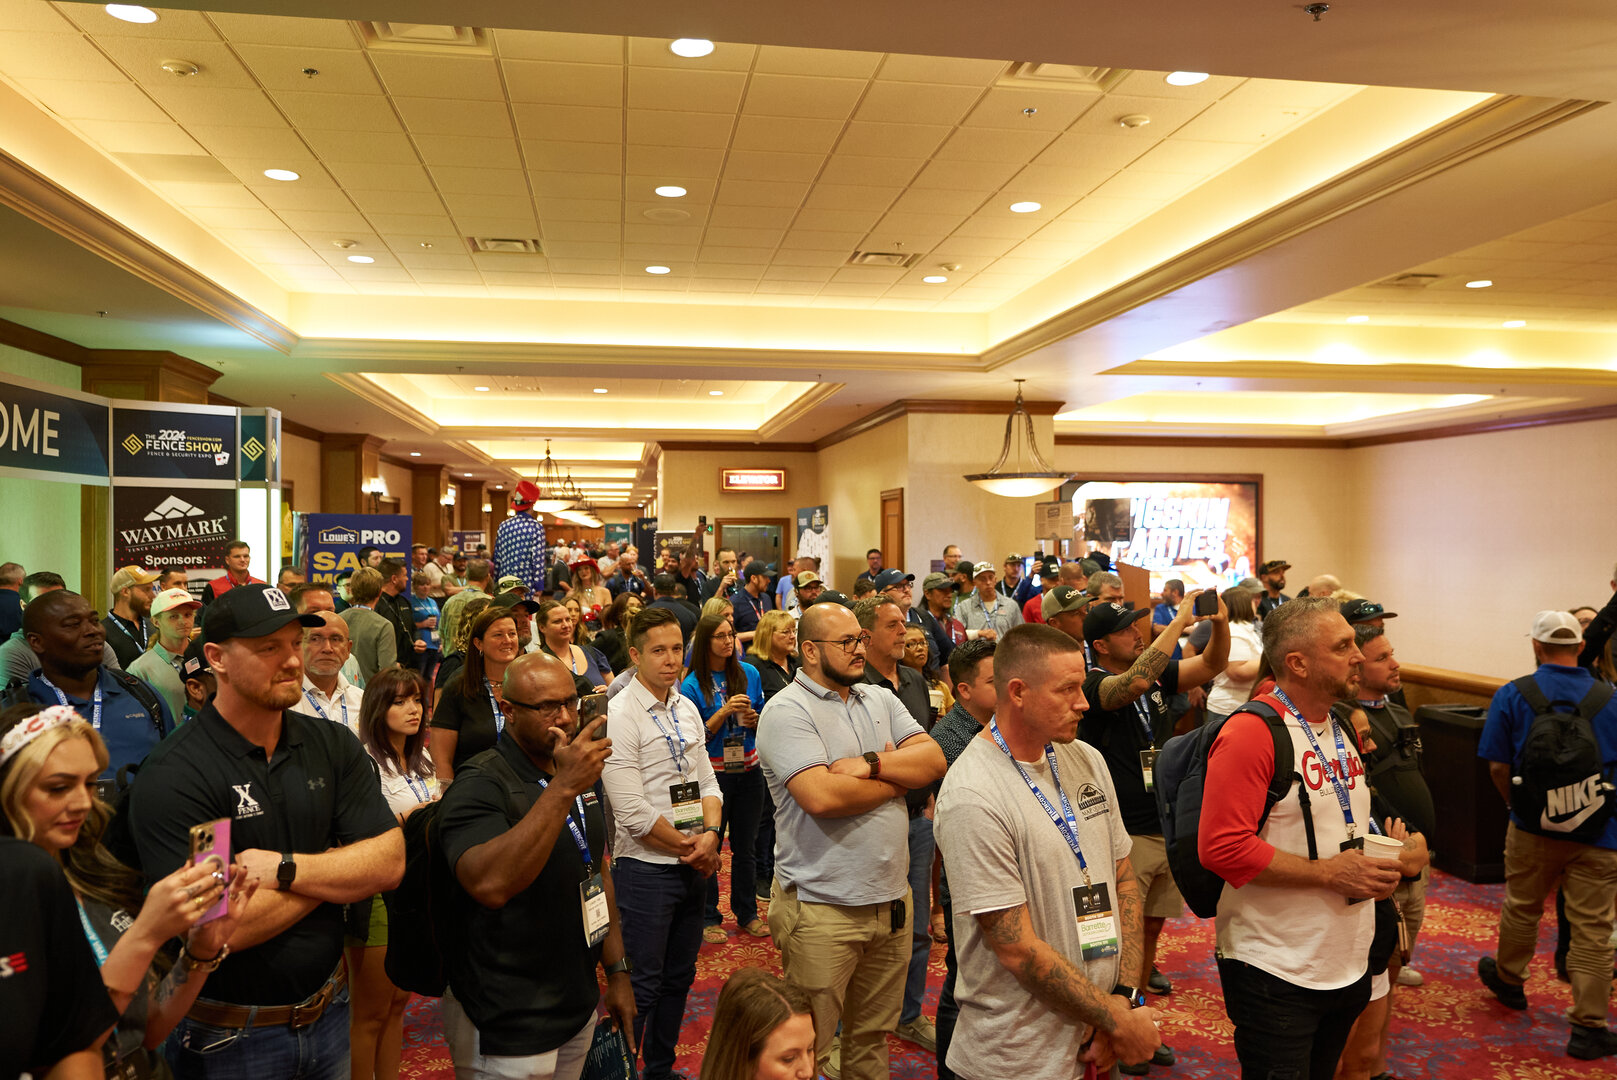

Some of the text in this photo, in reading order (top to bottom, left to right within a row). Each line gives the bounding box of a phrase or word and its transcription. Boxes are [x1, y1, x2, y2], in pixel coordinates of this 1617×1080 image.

[158, 429, 186, 441] 2024
[145, 440, 222, 453] FENCESHOW
[1130, 497, 1230, 528] IGSKIN
[120, 518, 225, 545] WAYMARK
[361, 529, 401, 545] PRO
[145, 554, 207, 567] Sponsors:
[1547, 773, 1601, 818] NIKE
[1080, 921, 1106, 932] Barrette
